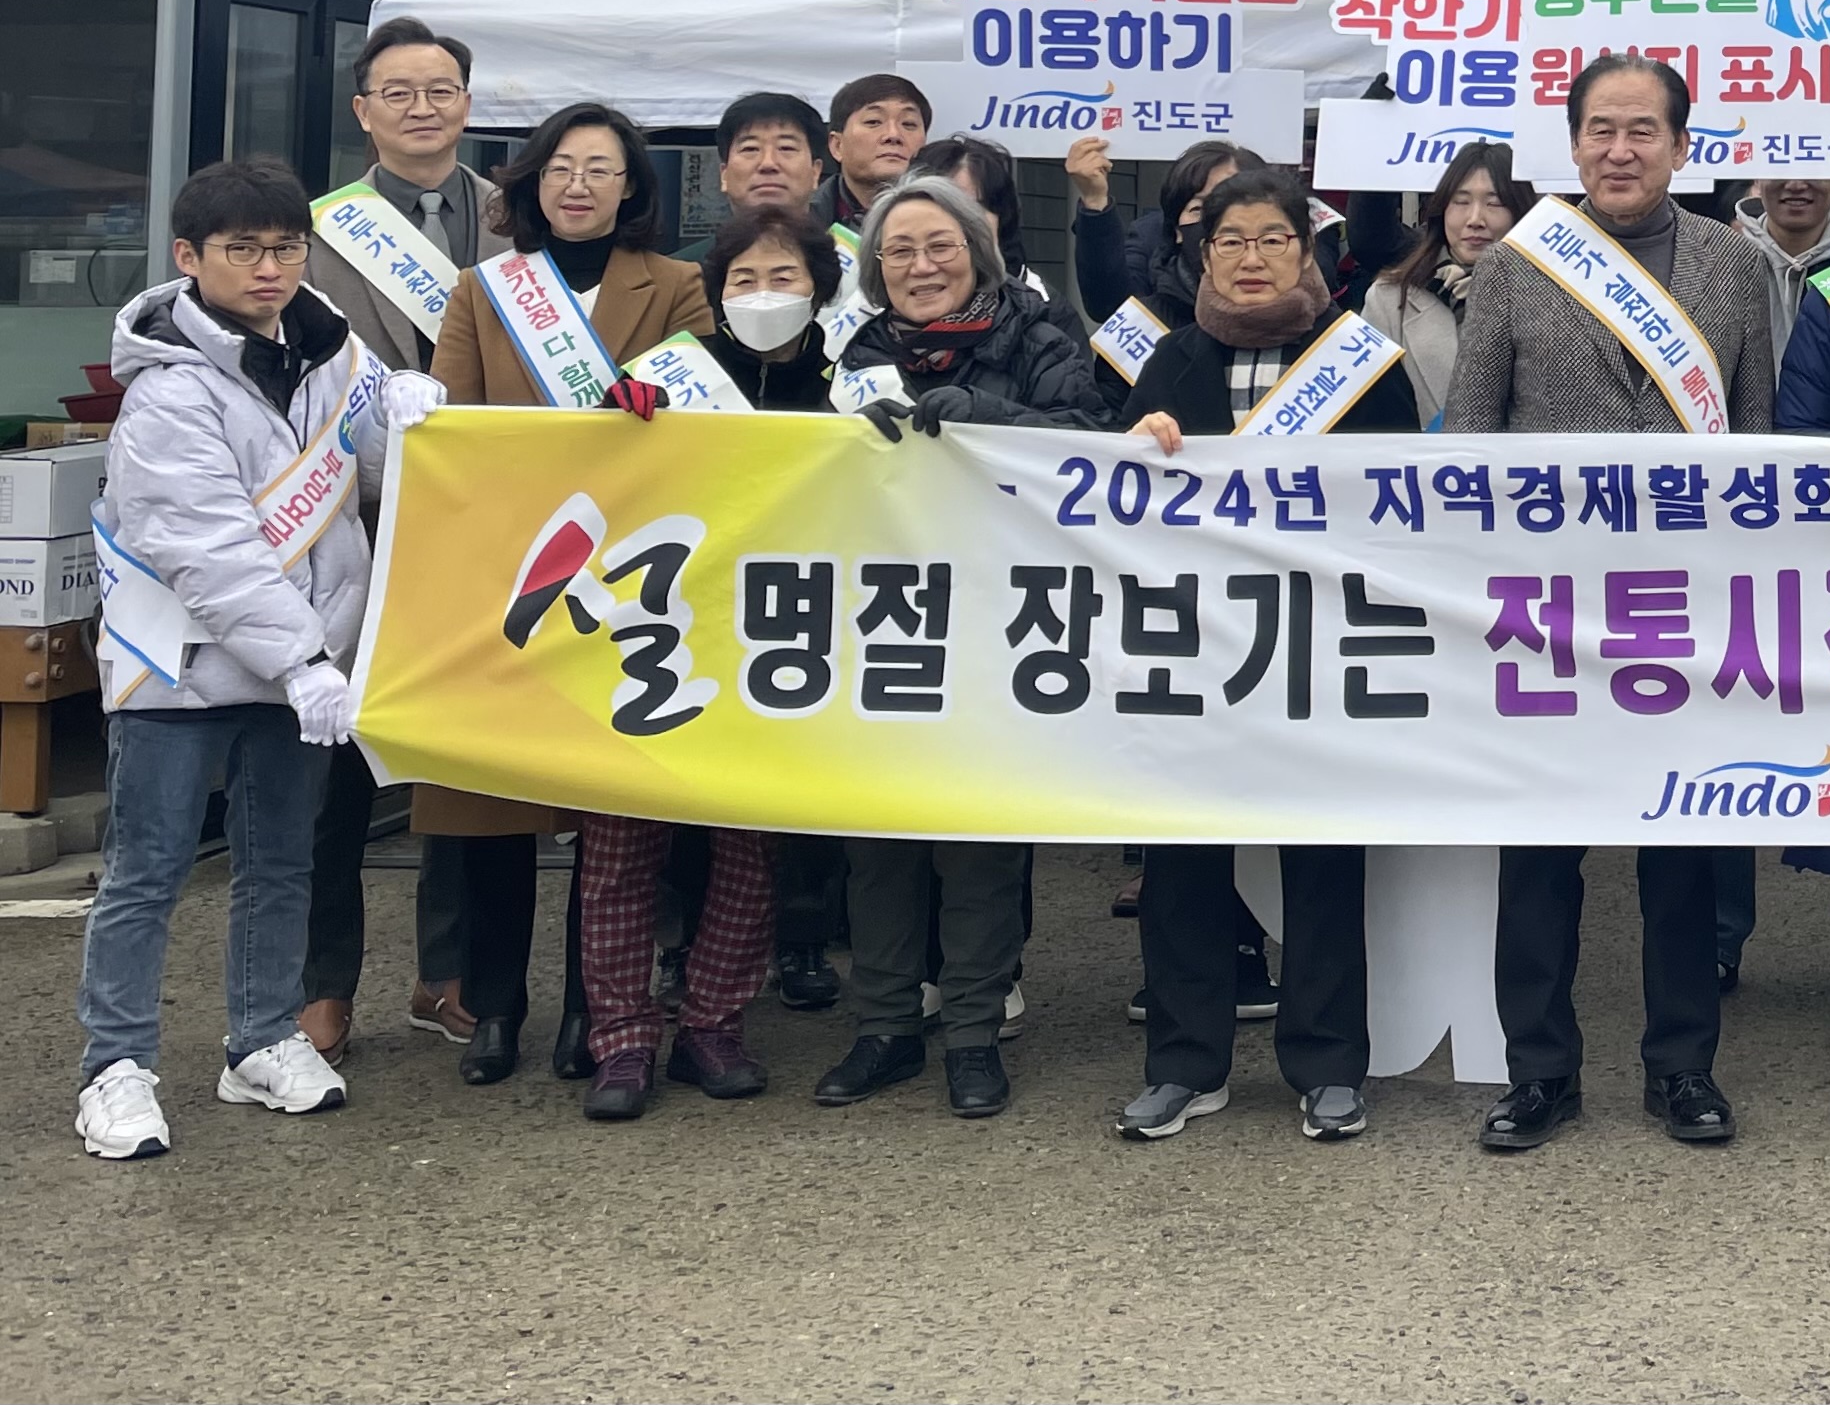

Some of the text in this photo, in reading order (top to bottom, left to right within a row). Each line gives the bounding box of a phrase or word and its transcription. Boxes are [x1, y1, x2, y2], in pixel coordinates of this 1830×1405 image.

[972, 7, 1232, 74] 이용하기
[969, 95, 1098, 131] Jindo
[1131, 100, 1234, 133] 진도군
[332, 203, 397, 259] 모두가
[1539, 222, 1609, 280] 모두가
[1604, 272, 1691, 368] 실천하는
[542, 331, 576, 358] 다
[1056, 456, 1331, 532] 2024년
[60, 570, 100, 591] DIA
[502, 518, 705, 737] 설
[742, 561, 951, 714] 명절
[1005, 564, 1434, 721] 장보기는
[1640, 770, 1813, 821] Jindo
